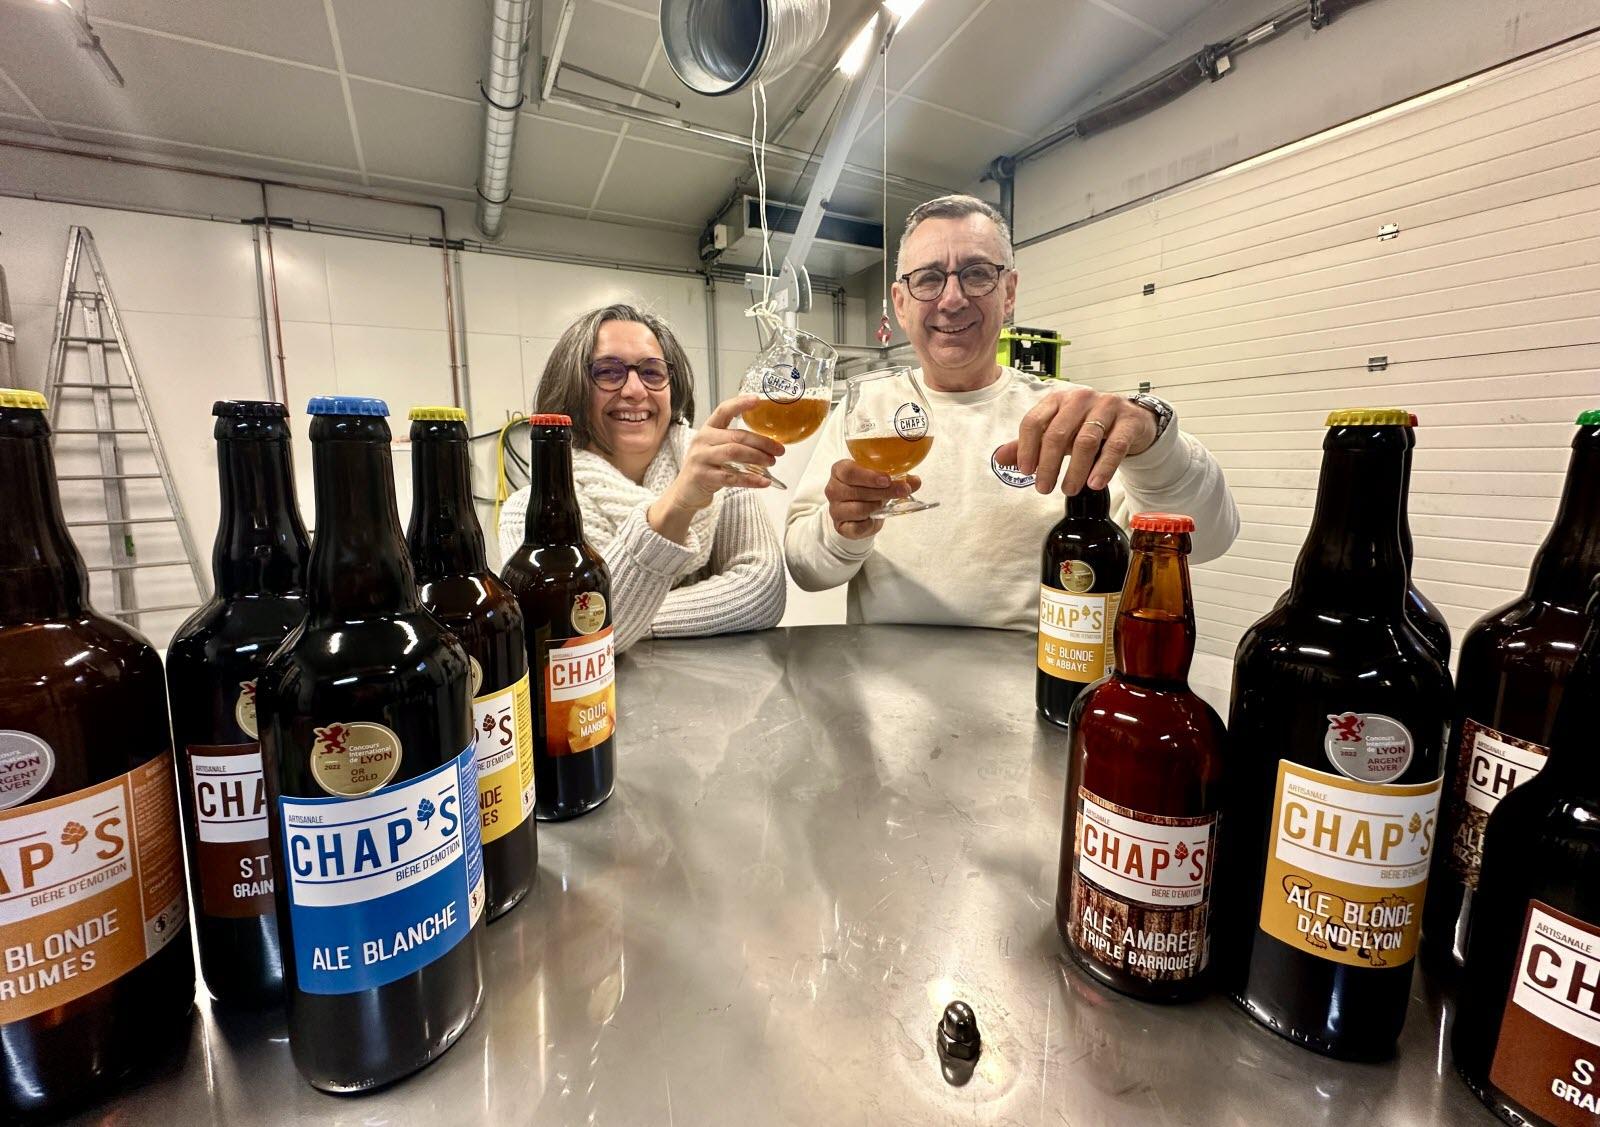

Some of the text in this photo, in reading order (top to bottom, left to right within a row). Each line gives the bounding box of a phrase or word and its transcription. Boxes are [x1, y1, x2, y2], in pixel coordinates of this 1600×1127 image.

[1059, 647, 1094, 662] BLONDE
[1056, 659, 1087, 673] ABBAYE
[579, 701, 607, 724] SOUR
[349, 743, 380, 752] Concours
[349, 746, 392, 758] International
[1377, 746, 1405, 755] LYON
[361, 752, 392, 764] LYON
[1368, 757, 1403, 765] ARGENT
[351, 768, 365, 776] OR
[351, 773, 378, 783] GOLD
[1288, 783, 1328, 802] ARTISANALE
[289, 814, 324, 824] ARTISANALE
[291, 795, 459, 878] CHAP'S
[1284, 801, 1433, 861] CHAP'S
[396, 841, 461, 882] BIÈRE D'ÉMOTION
[1083, 823, 1205, 882] CHAP'S
[31, 887, 66, 907] BIÈRE
[1152, 887, 1170, 898] BIÈRE
[1286, 886, 1415, 928] ALE BLONDE
[312, 901, 458, 972] ALE BLANCHE
[1083, 906, 1198, 953] ALE AMBRÉE
[1297, 914, 1402, 950] DANDELYON
[1536, 922, 1593, 954] ARTISANALE
[5, 908, 120, 973] BLONDE
[1082, 928, 1122, 960] TRIPLE
